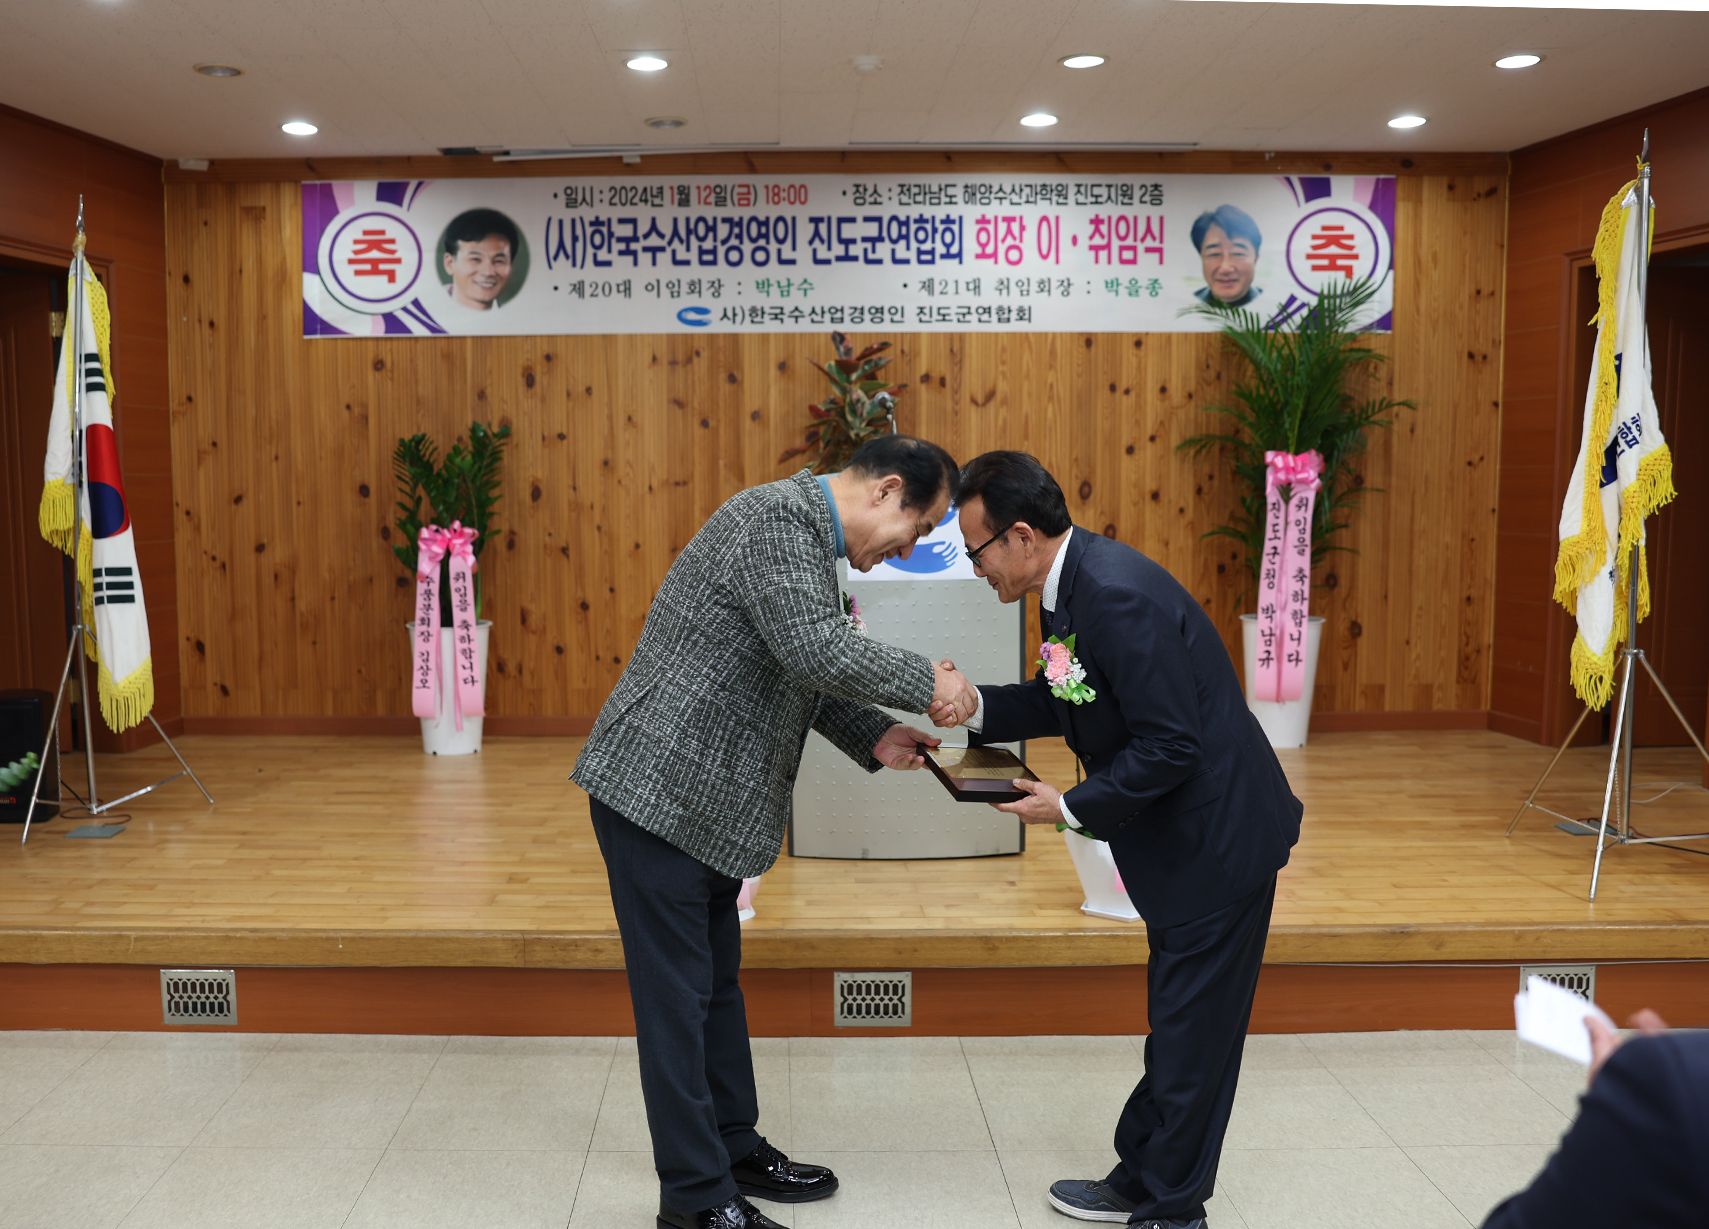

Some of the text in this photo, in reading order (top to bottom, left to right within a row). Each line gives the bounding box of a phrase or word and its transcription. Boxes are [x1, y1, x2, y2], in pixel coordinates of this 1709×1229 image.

[564, 185, 594, 208] 일시
[608, 185, 664, 207] 2024년
[669, 184, 691, 207] 1월
[695, 184, 758, 208] 12일(금)
[764, 183, 808, 206] 18:00
[852, 183, 883, 206] 장소
[897, 183, 958, 206] 전라남도
[963, 183, 1069, 206] 해양수산과학원
[1074, 183, 1134, 206] 진도지원
[1139, 183, 1164, 206] 2층
[347, 228, 403, 285] 축
[545, 214, 797, 270] (사)한국수산업경영인
[807, 213, 963, 265] 진도군연합회
[975, 214, 1027, 266] 회장
[1088, 213, 1164, 265] 취임식
[1305, 225, 1360, 280] 축
[568, 278, 632, 299] 제20대
[644, 278, 725, 299] 이임회장
[755, 277, 815, 298] 박남수
[720, 305, 1032, 325] 사)한국수산업경영인 진도군연합회
[918, 277, 981, 297] 제21대
[994, 277, 1074, 297] 취임회장
[1104, 277, 1164, 298] 박을종
[1287, 496, 1309, 669] 취임을 축하합니다
[453, 570, 479, 687] 취임을 축하합니다
[1258, 602, 1276, 670] 박남규
